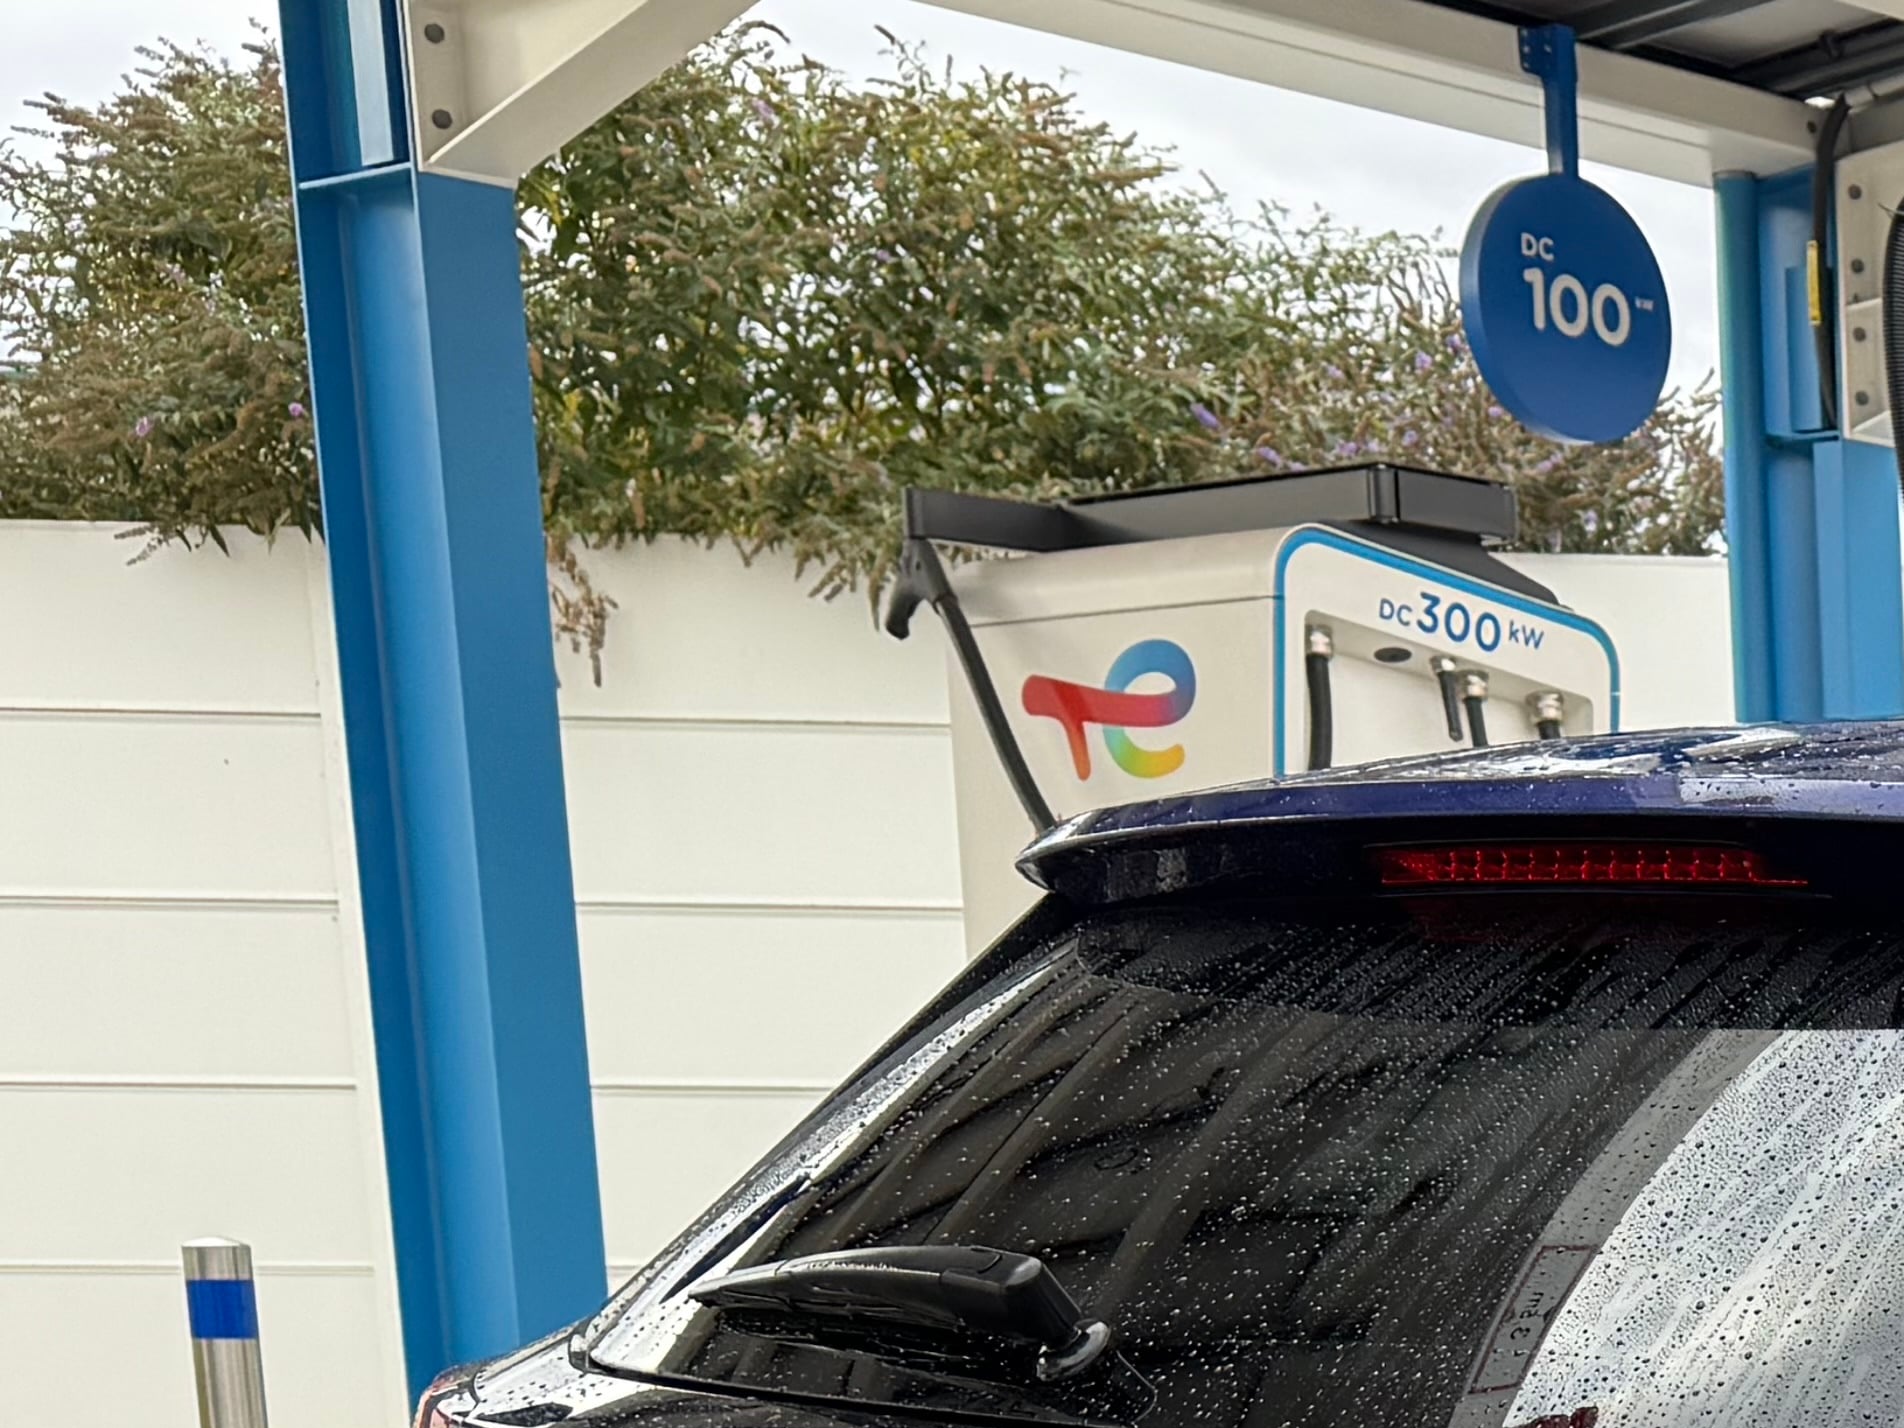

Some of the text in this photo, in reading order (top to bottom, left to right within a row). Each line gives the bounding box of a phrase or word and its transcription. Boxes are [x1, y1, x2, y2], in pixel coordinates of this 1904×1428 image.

[1521, 231, 1554, 262] DC
[1523, 267, 1631, 347] 100
[1379, 591, 1545, 653] DC 300 kW
